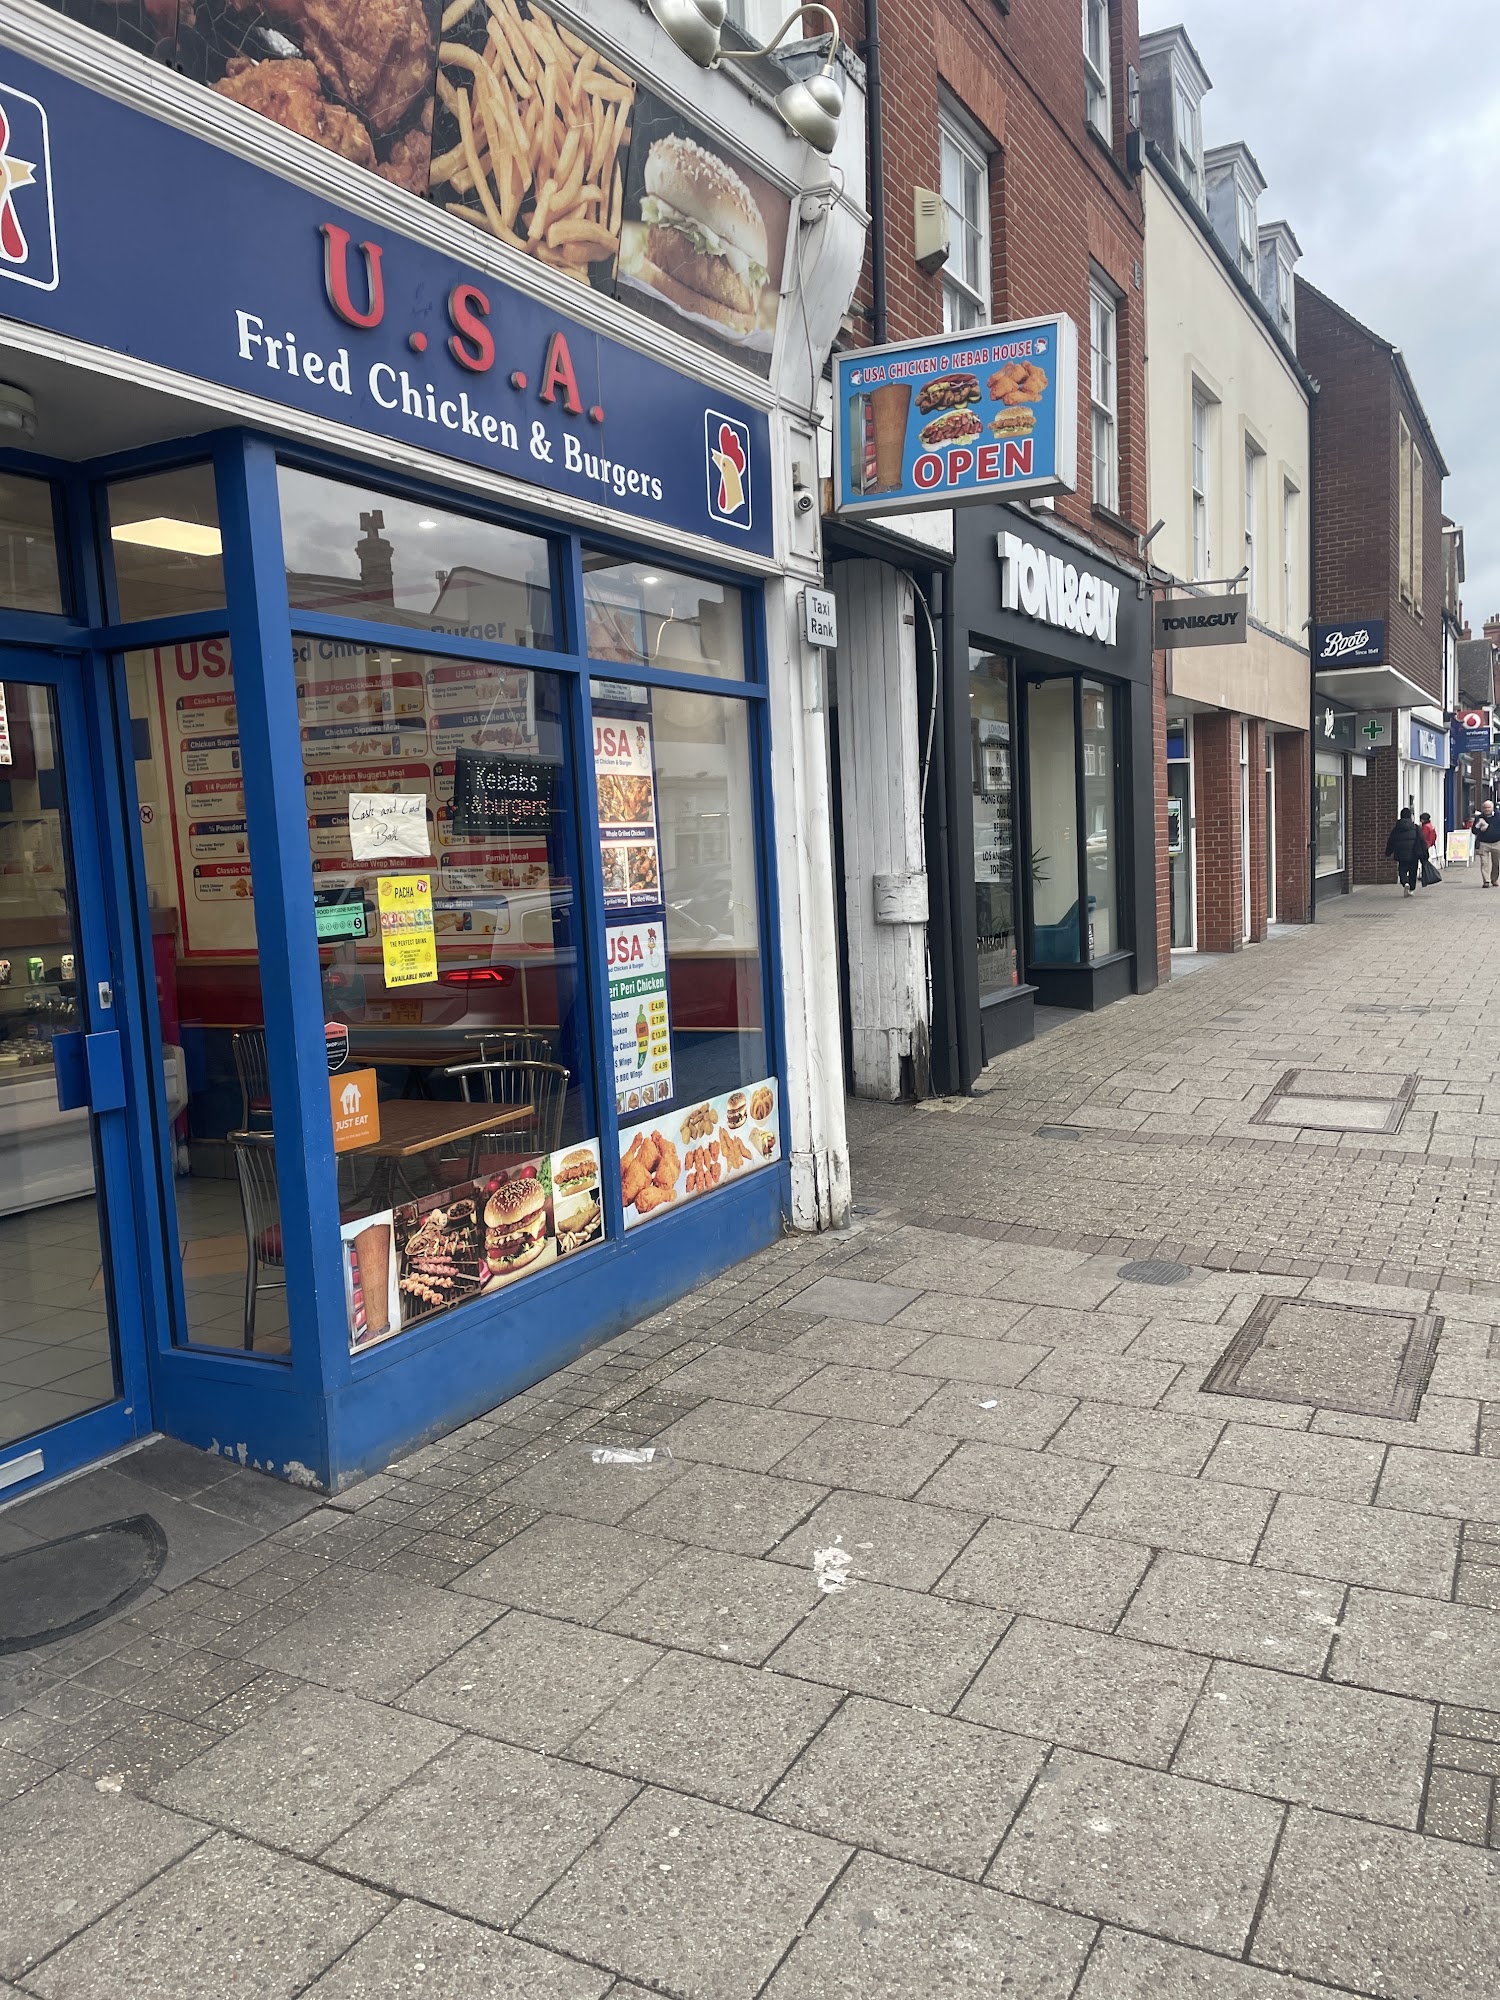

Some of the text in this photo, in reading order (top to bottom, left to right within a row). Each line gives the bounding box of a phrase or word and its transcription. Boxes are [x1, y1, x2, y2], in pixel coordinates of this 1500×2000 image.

[319, 222, 605, 424] U.S.A.
[863, 340, 1033, 384] USA CHICKEN & KEBAB HOUSE
[235, 309, 664, 502] Fried Chicken & Burgers
[912, 438, 1034, 489] OPEN
[997, 530, 1120, 646] TONI&GUY
[812, 596, 830, 616] Taxi
[811, 617, 834, 638] Rank
[1162, 612, 1241, 631] TONI&GUY
[1320, 629, 1370, 658] Boots
[174, 639, 234, 681] US
[456, 670, 471, 678] USA
[472, 668, 486, 676] Hot
[462, 715, 478, 724] USA
[480, 712, 504, 722] Grilled
[354, 726, 381, 736] Dippers
[383, 723, 400, 731] Meal
[988, 724, 1009, 736] LONDON
[190, 740, 216, 749] Chicken
[328, 773, 356, 781] Chicken
[358, 771, 386, 780] Nuggets
[477, 766, 538, 792] Kebabs
[980, 794, 996, 804] HONG
[352, 800, 374, 821] Cash
[380, 799, 397, 817] and
[370, 822, 399, 847] Both
[485, 854, 509, 864] Family
[510, 852, 528, 860] Meal
[982, 850, 992, 861] LOS
[341, 861, 368, 869] Chicken
[370, 860, 388, 868] Wrap
[394, 884, 414, 899] PACHA
[418, 882, 428, 892] TV
[434, 901, 454, 909] Wrap
[356, 918, 360, 928] 5
[398, 938, 415, 946] PERFECT
[391, 973, 418, 982] AVAILABLE
[608, 976, 665, 998] eri Peri Chicken
[612, 1011, 630, 1020] Chicken
[612, 1027, 628, 1036] hicken
[620, 1040, 637, 1050] Chicken
[619, 1057, 632, 1067] Wings
[620, 1072, 628, 1082] BBQ
[336, 1114, 368, 1132] JUST EAT
